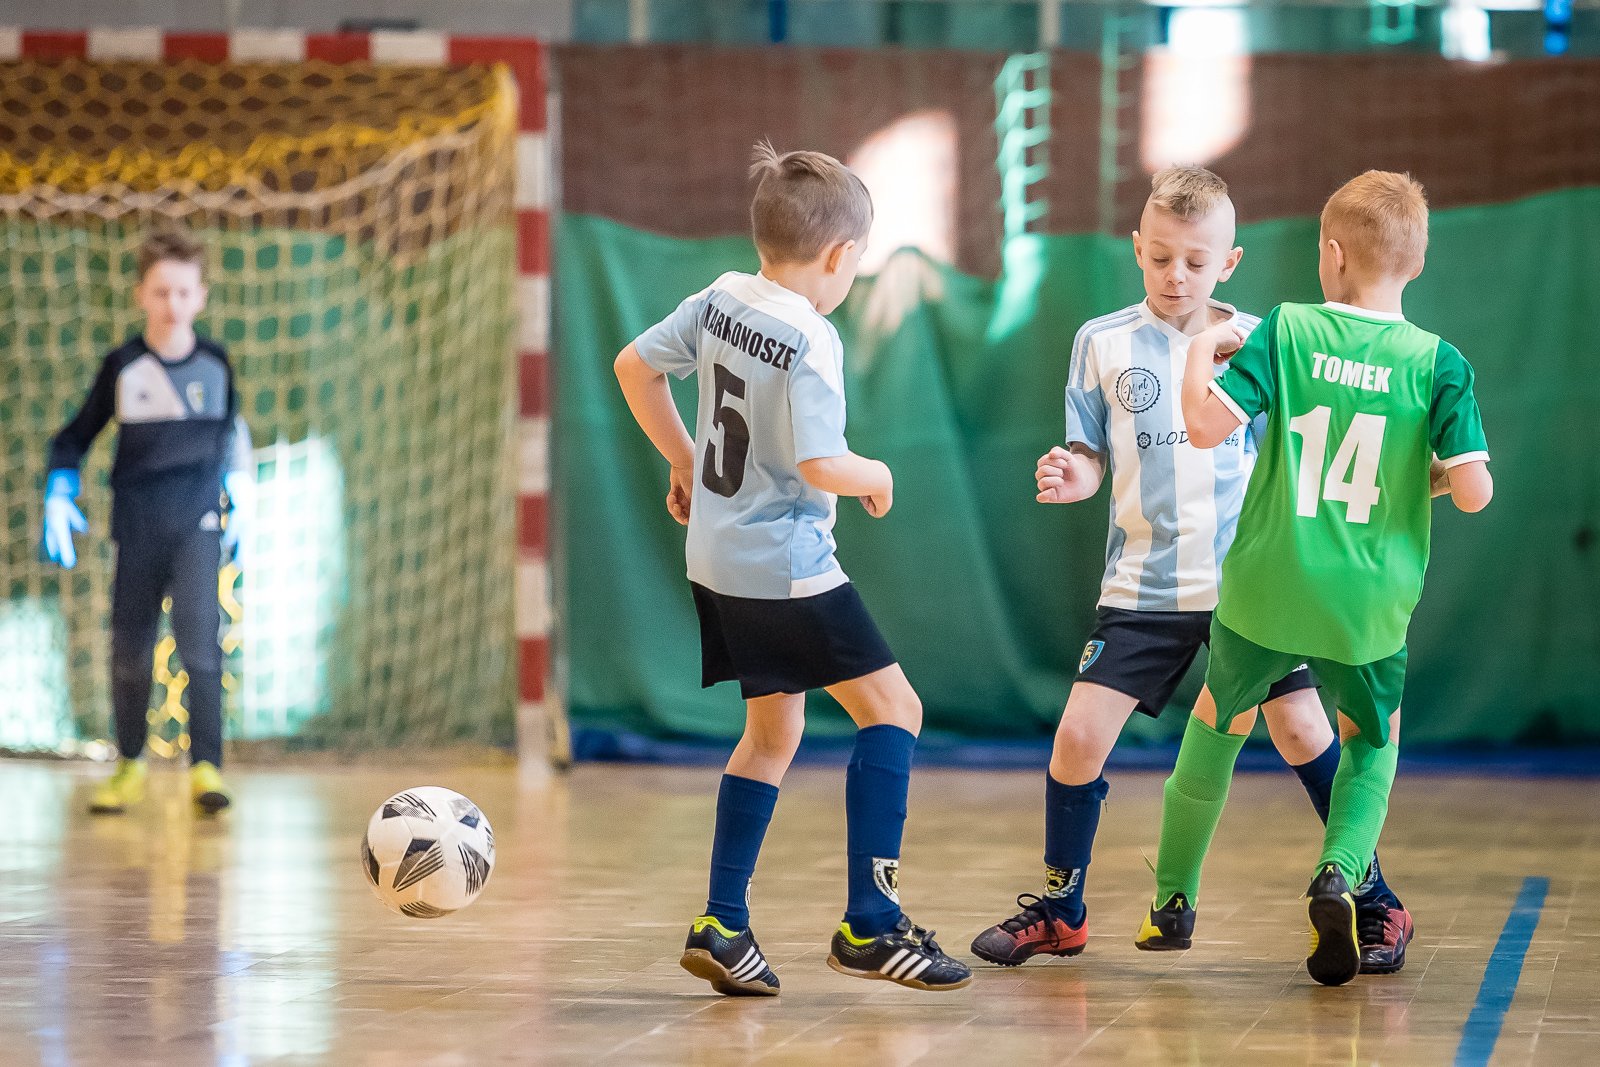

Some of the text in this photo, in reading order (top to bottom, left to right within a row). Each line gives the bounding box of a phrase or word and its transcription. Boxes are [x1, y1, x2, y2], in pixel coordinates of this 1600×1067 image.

[1311, 351, 1393, 394] TOMEK
[701, 362, 751, 499] 5
[1156, 431, 1189, 446] LOD
[1289, 404, 1387, 525] 14
